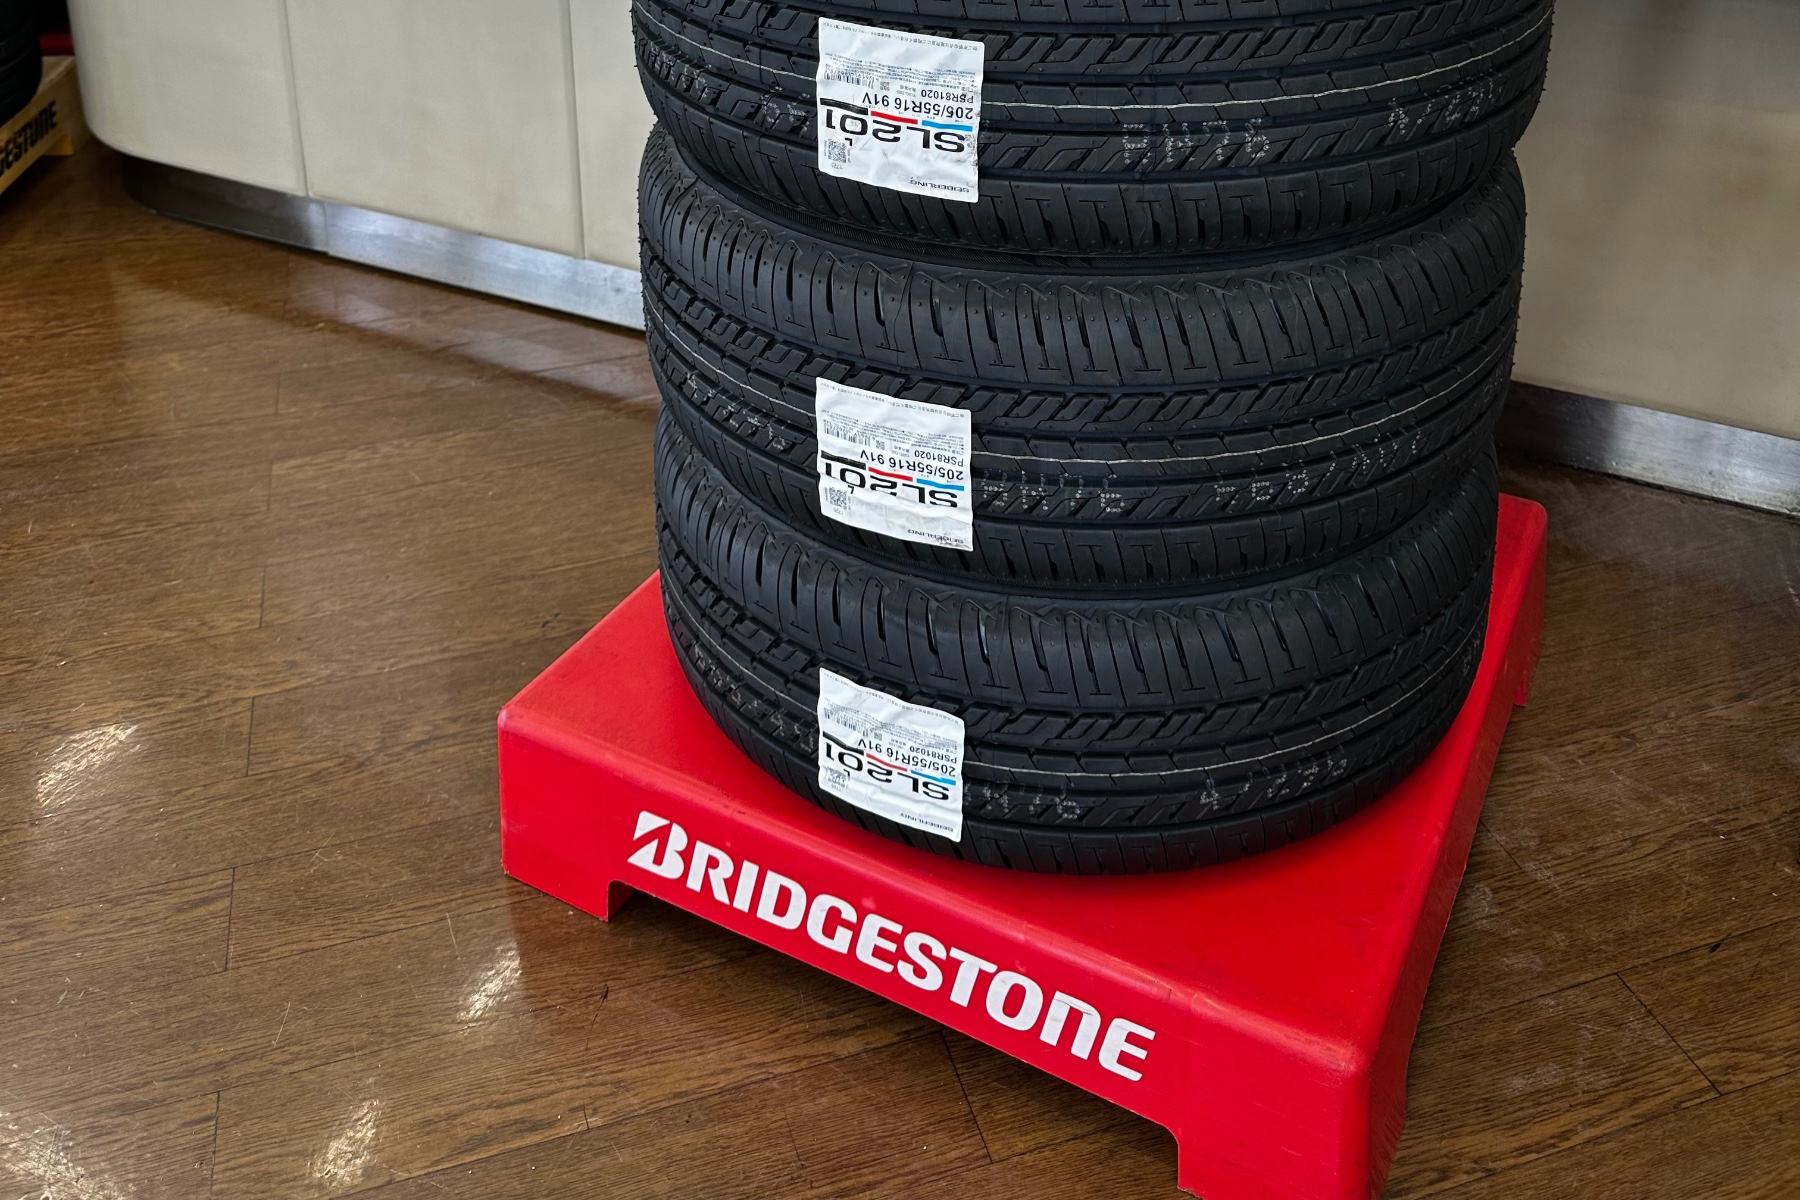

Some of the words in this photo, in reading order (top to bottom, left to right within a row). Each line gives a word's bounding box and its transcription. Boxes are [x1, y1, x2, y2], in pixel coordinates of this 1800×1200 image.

[862, 92, 890, 106] 91V
[921, 89, 973, 103] PSR81020
[895, 98, 973, 119] 205/55R16
[826, 109, 965, 152] SL201
[860, 449, 885, 465] 91V
[914, 450, 964, 467] PSR81020
[889, 457, 964, 481] 205/55R16
[825, 463, 958, 508] SL201
[858, 739, 882, 752] 91V
[910, 745, 957, 764] PSR81020
[826, 742, 949, 800] SL201
[886, 747, 956, 777] 205/55R16
[627, 810, 1156, 1081] BRIDGESTONE
